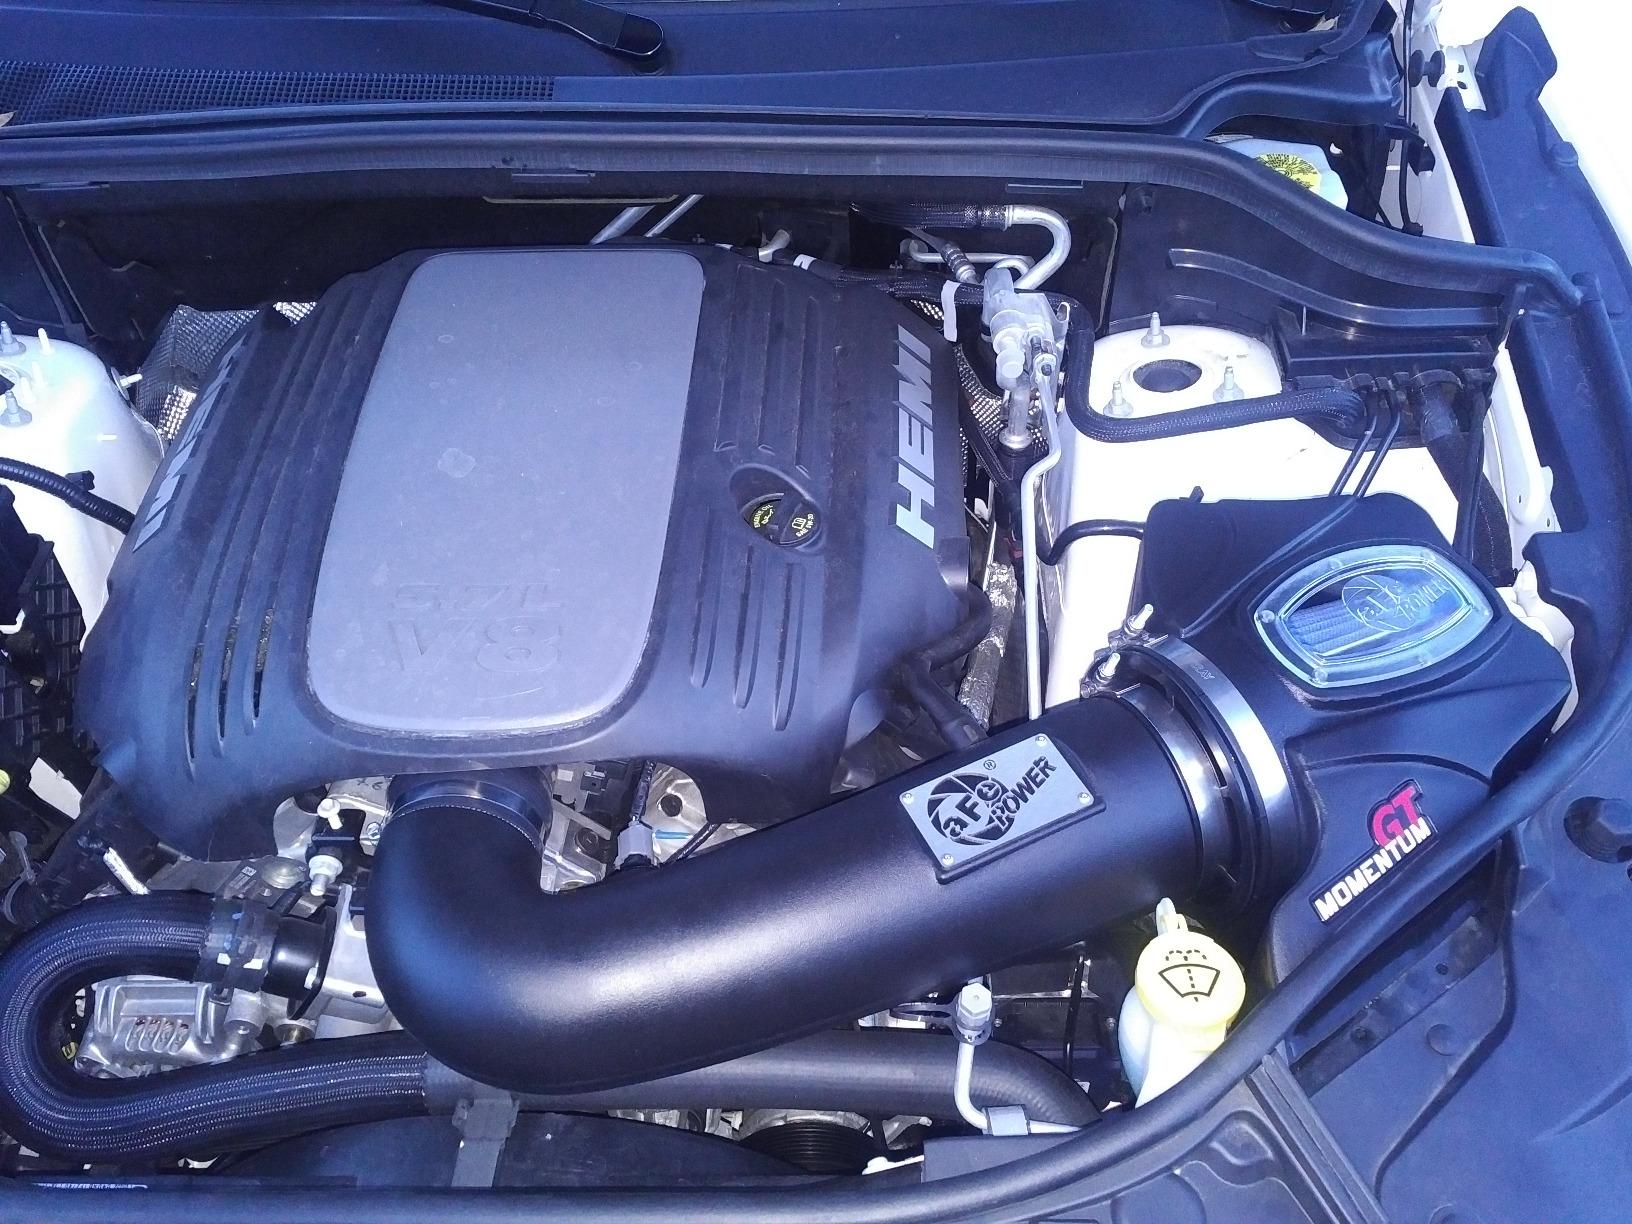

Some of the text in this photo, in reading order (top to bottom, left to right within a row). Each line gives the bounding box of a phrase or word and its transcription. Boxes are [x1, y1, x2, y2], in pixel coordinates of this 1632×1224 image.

[896, 324, 935, 550] HEMI
[754, 510, 764, 528] ENGINE
[796, 528, 808, 537] SAE
[385, 616, 562, 673] V8
[990, 756, 1057, 828] POWER
[1372, 785, 1416, 848] GT
[1314, 816, 1432, 922] MOMENTUM
